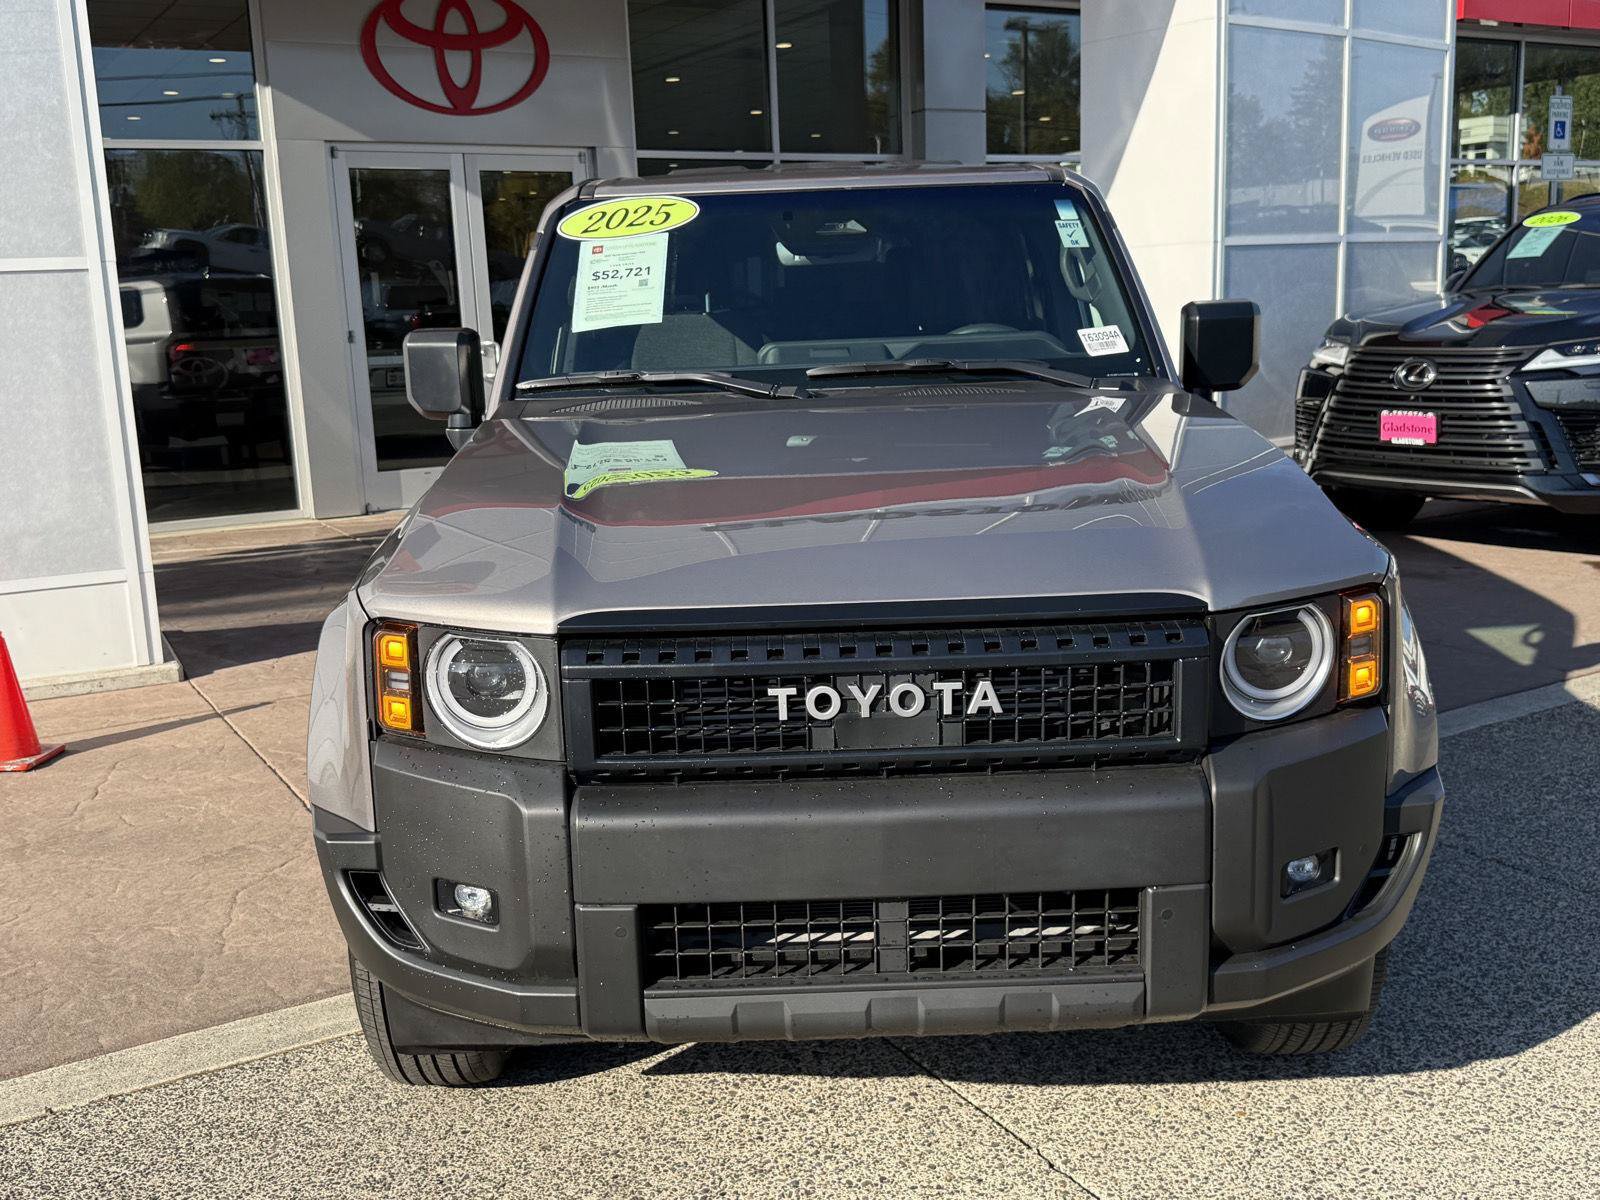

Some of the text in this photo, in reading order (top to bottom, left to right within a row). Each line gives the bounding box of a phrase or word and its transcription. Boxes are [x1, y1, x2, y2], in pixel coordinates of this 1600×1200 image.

[1551, 110, 1569, 119] PARKING
[581, 203, 676, 234] 2025
[591, 266, 651, 282] $52,721
[1082, 330, 1121, 343] T63094A
[1382, 422, 1433, 434] Gladstone
[767, 680, 1004, 721] TOYOTA
